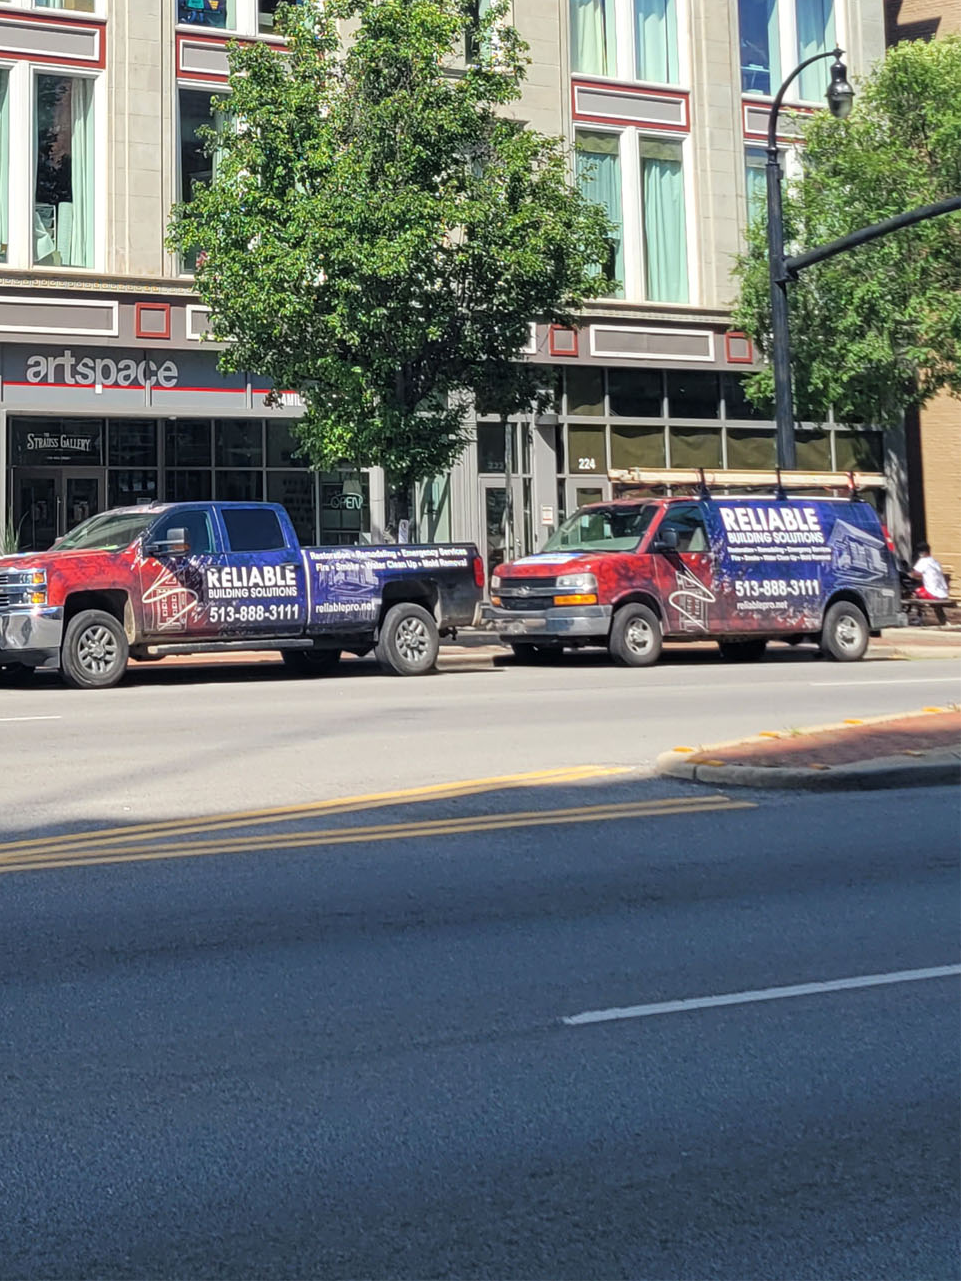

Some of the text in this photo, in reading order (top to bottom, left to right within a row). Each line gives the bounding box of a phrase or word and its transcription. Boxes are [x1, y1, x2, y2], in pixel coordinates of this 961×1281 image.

[26, 350, 179, 388] artspace
[578, 457, 597, 470] 224
[330, 495, 362, 510] OPEN
[719, 507, 821, 531] RELIABLE
[726, 531, 825, 544] BUILDING SOLUTIONS
[315, 563, 330, 572] Fire
[406, 559, 418, 569] Up
[207, 565, 297, 588] RELIABLE
[208, 586, 298, 599] BUILDING SOLUTIONS
[734, 579, 819, 597] 513-888-3111
[209, 603, 299, 623] 513-888-3111
[315, 602, 376, 614] reliablepro.net
